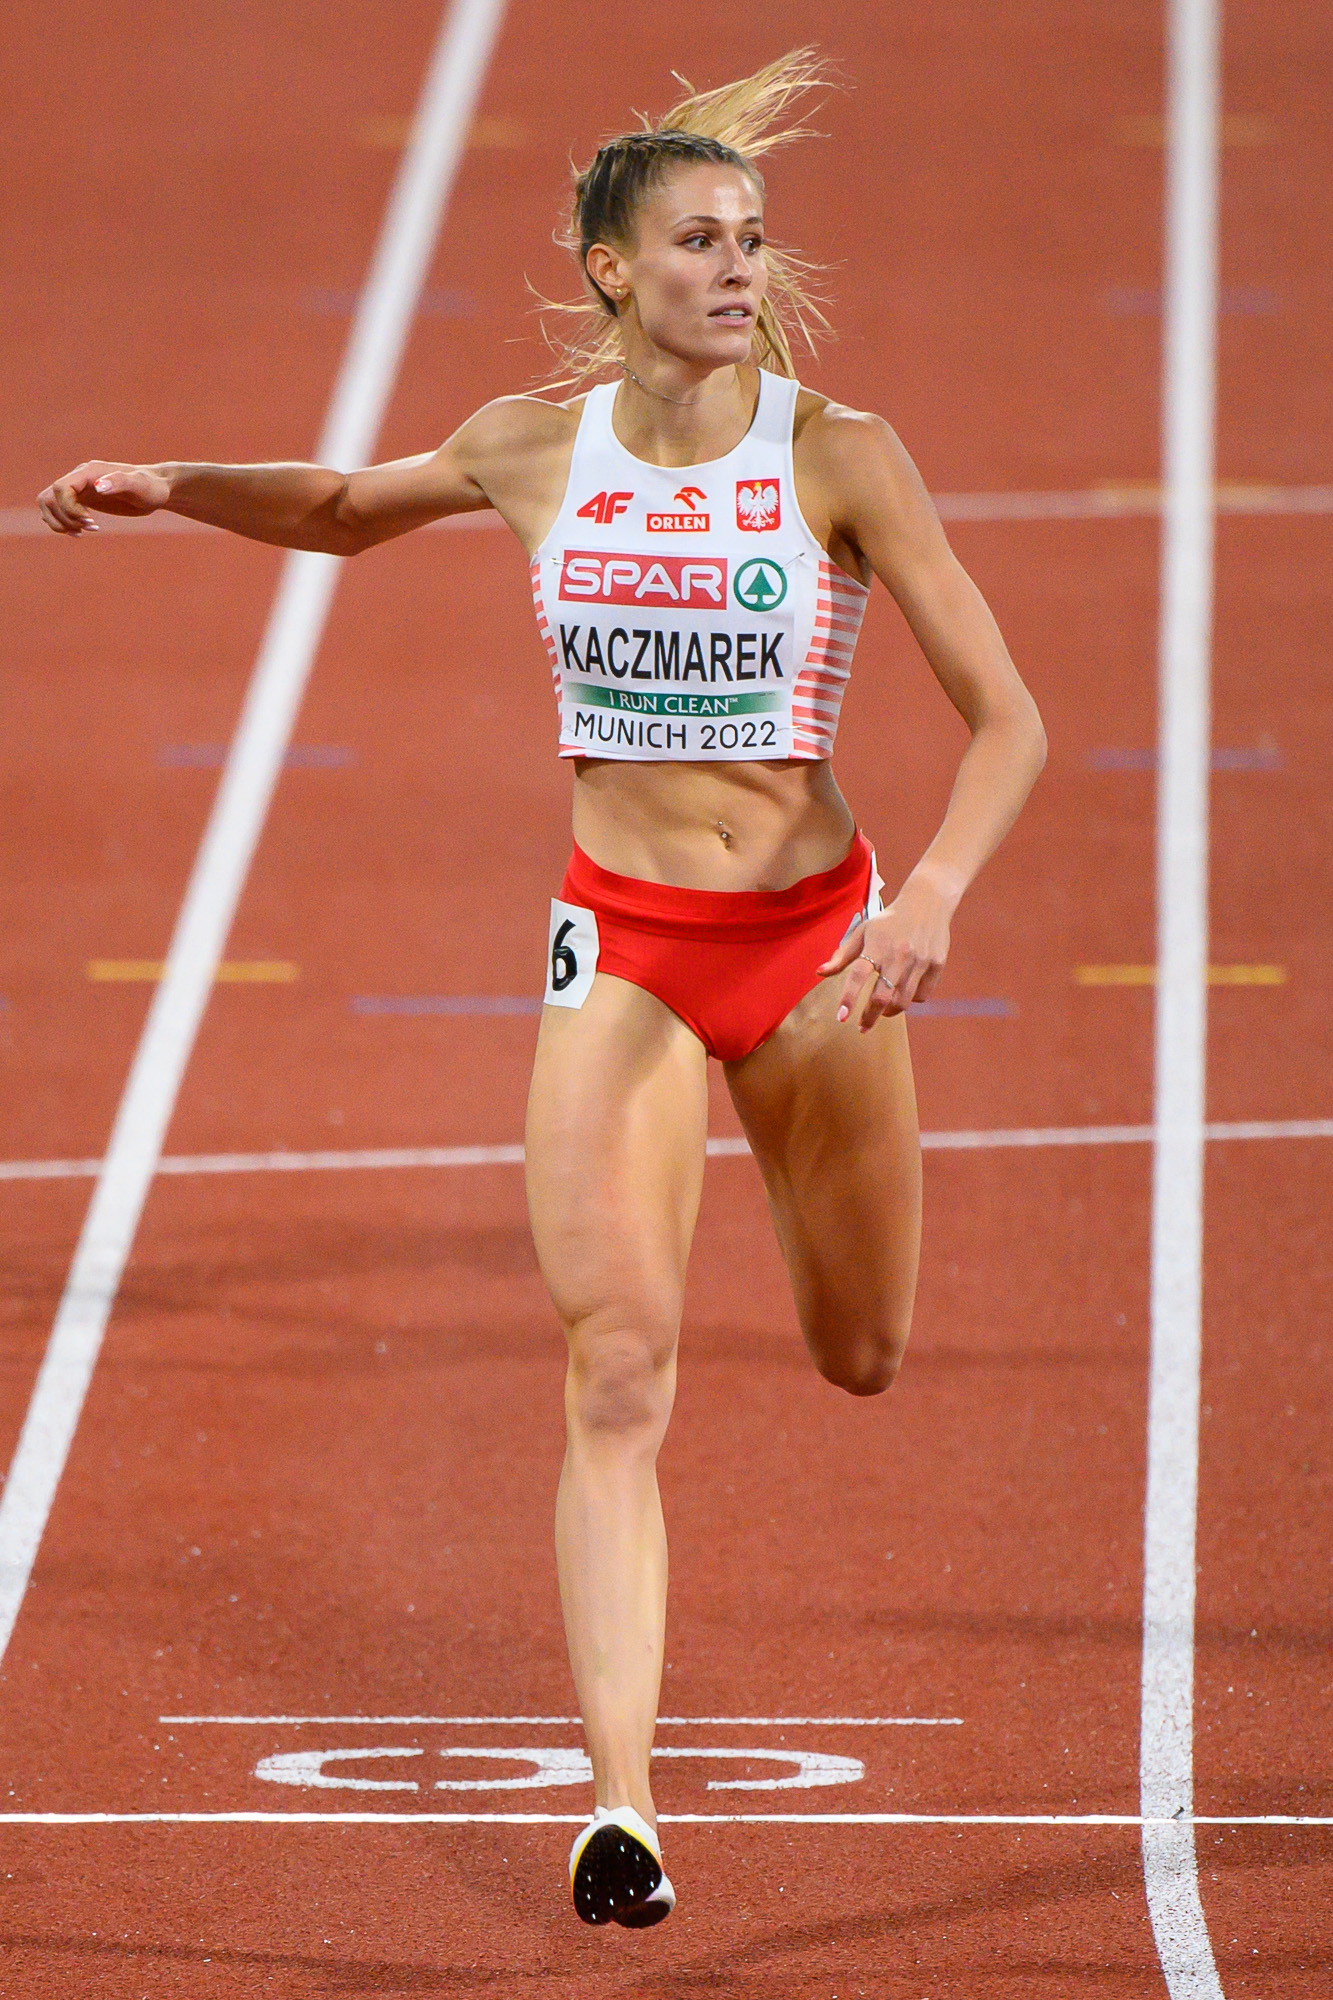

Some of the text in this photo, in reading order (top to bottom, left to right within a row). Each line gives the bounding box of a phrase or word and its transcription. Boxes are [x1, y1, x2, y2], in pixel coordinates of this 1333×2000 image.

[577, 491, 635, 524] 4F
[649, 516, 706, 530] ORLEN
[564, 558, 722, 602] SPAR
[559, 623, 785, 682] KACZMAREK
[609, 690, 615, 707] I
[619, 695, 658, 713] RUN
[574, 711, 777, 750] MUNICH 2022
[552, 918, 577, 992] 6
